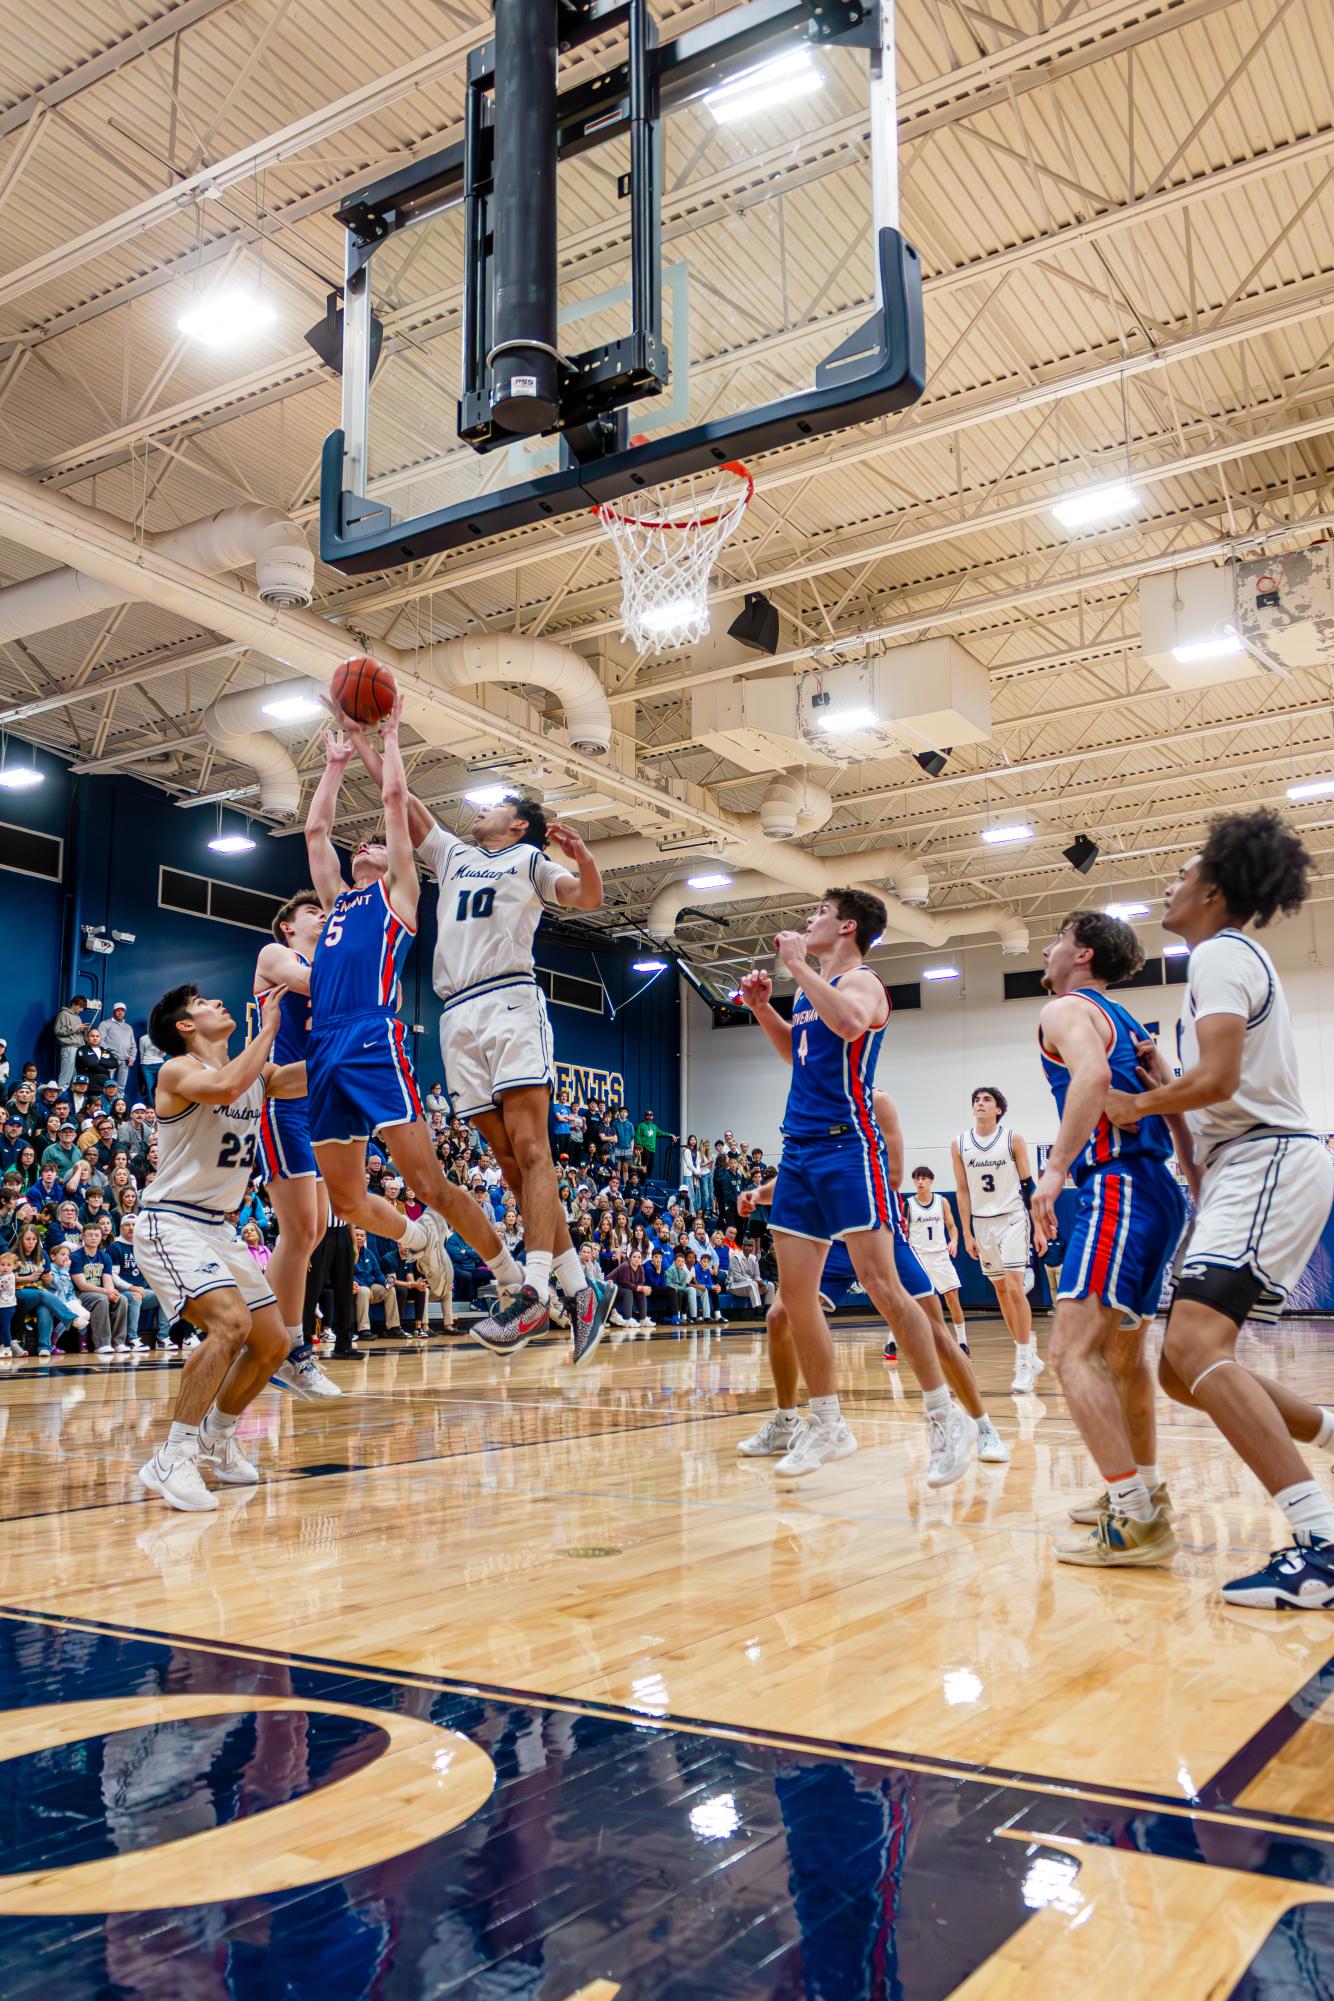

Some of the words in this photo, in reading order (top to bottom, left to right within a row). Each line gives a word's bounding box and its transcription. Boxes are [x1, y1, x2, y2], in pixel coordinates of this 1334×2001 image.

[456, 886, 497, 921] 10
[324, 914, 347, 947] 5
[797, 1029, 808, 1066] 4
[217, 1131, 256, 1168] 23
[967, 1158, 1007, 1170] Mustangs
[981, 1174, 996, 1193] 3
[927, 1226, 933, 1241] 1
